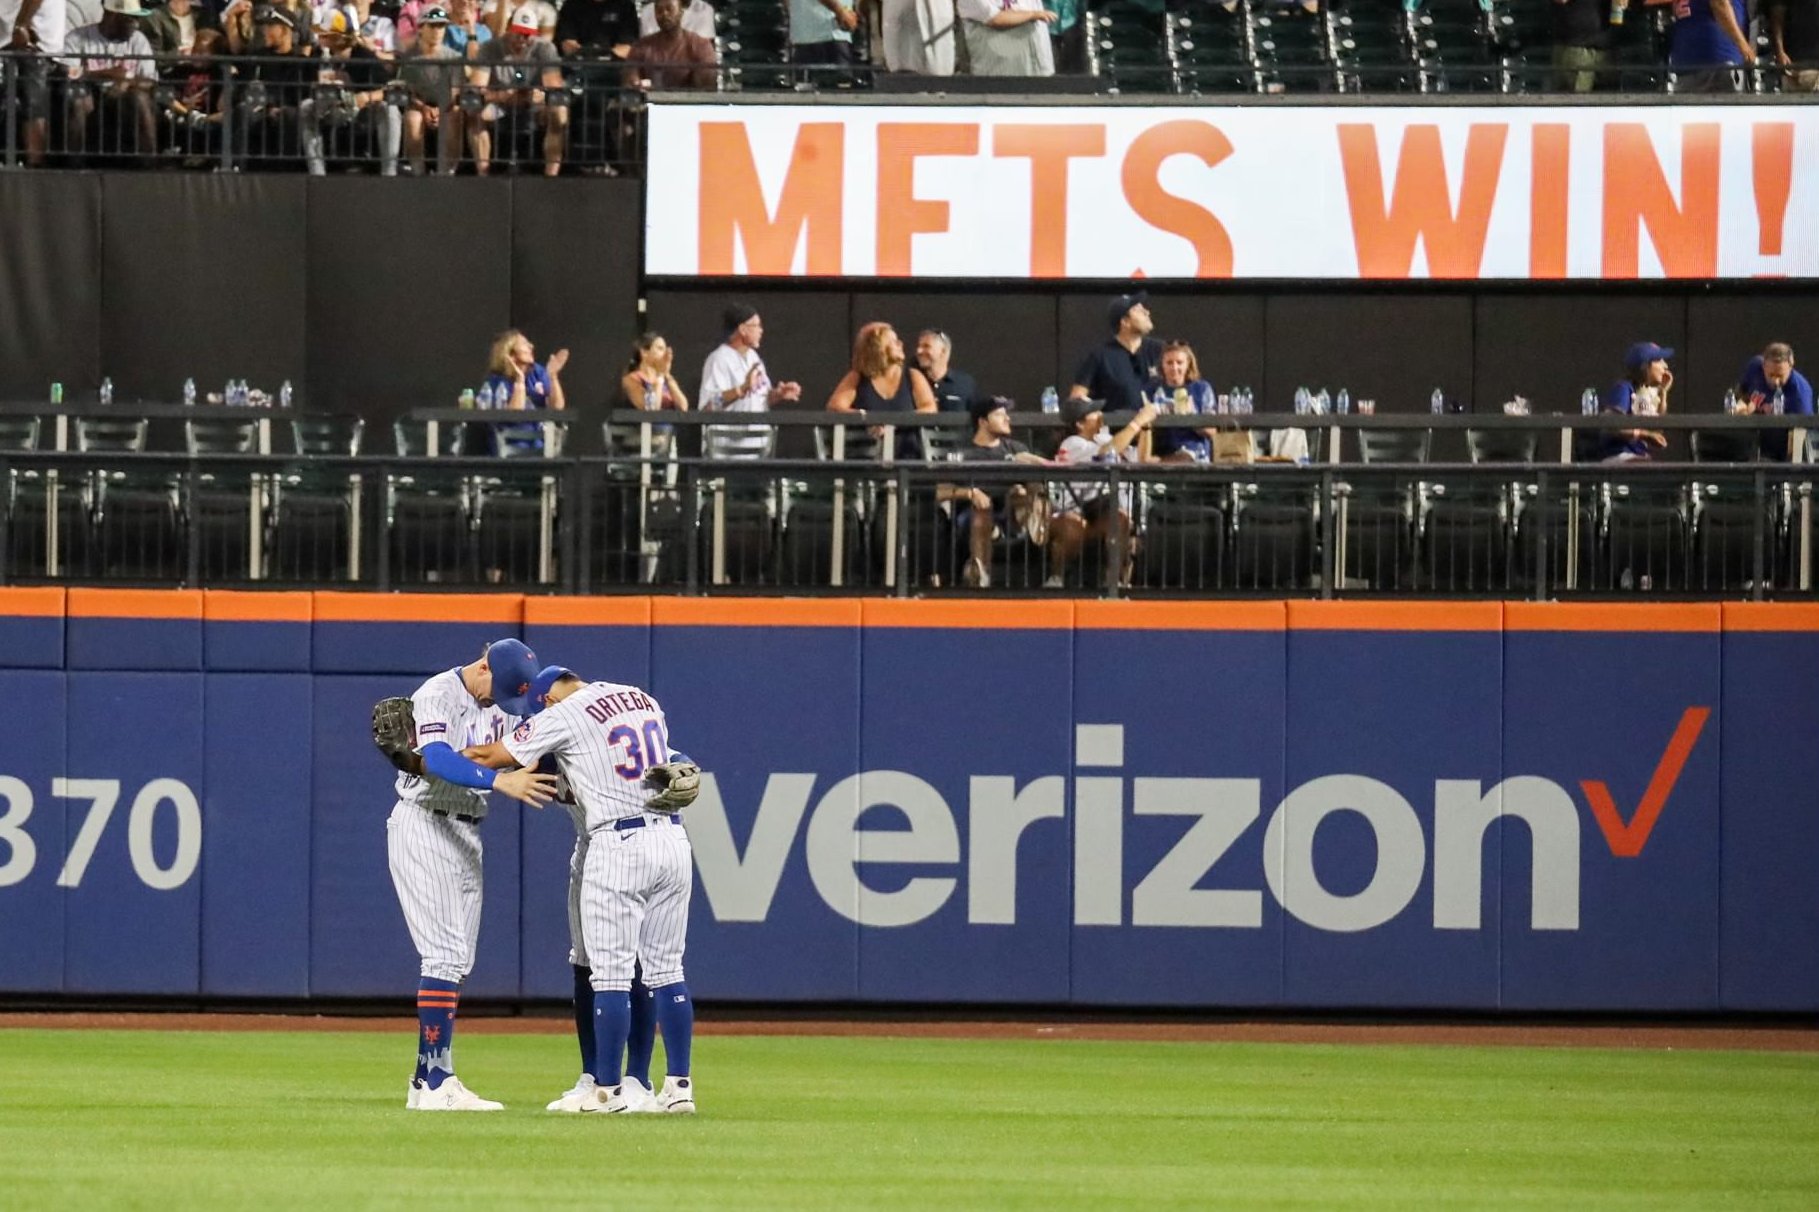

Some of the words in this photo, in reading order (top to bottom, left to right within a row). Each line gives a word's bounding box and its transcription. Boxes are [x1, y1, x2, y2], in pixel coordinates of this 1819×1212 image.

[698, 120, 1235, 278] METS
[1336, 123, 1795, 278] WIN!
[585, 691, 655, 724] ORTEGA
[607, 719, 668, 781] 30
[682, 723, 1580, 933] verizon
